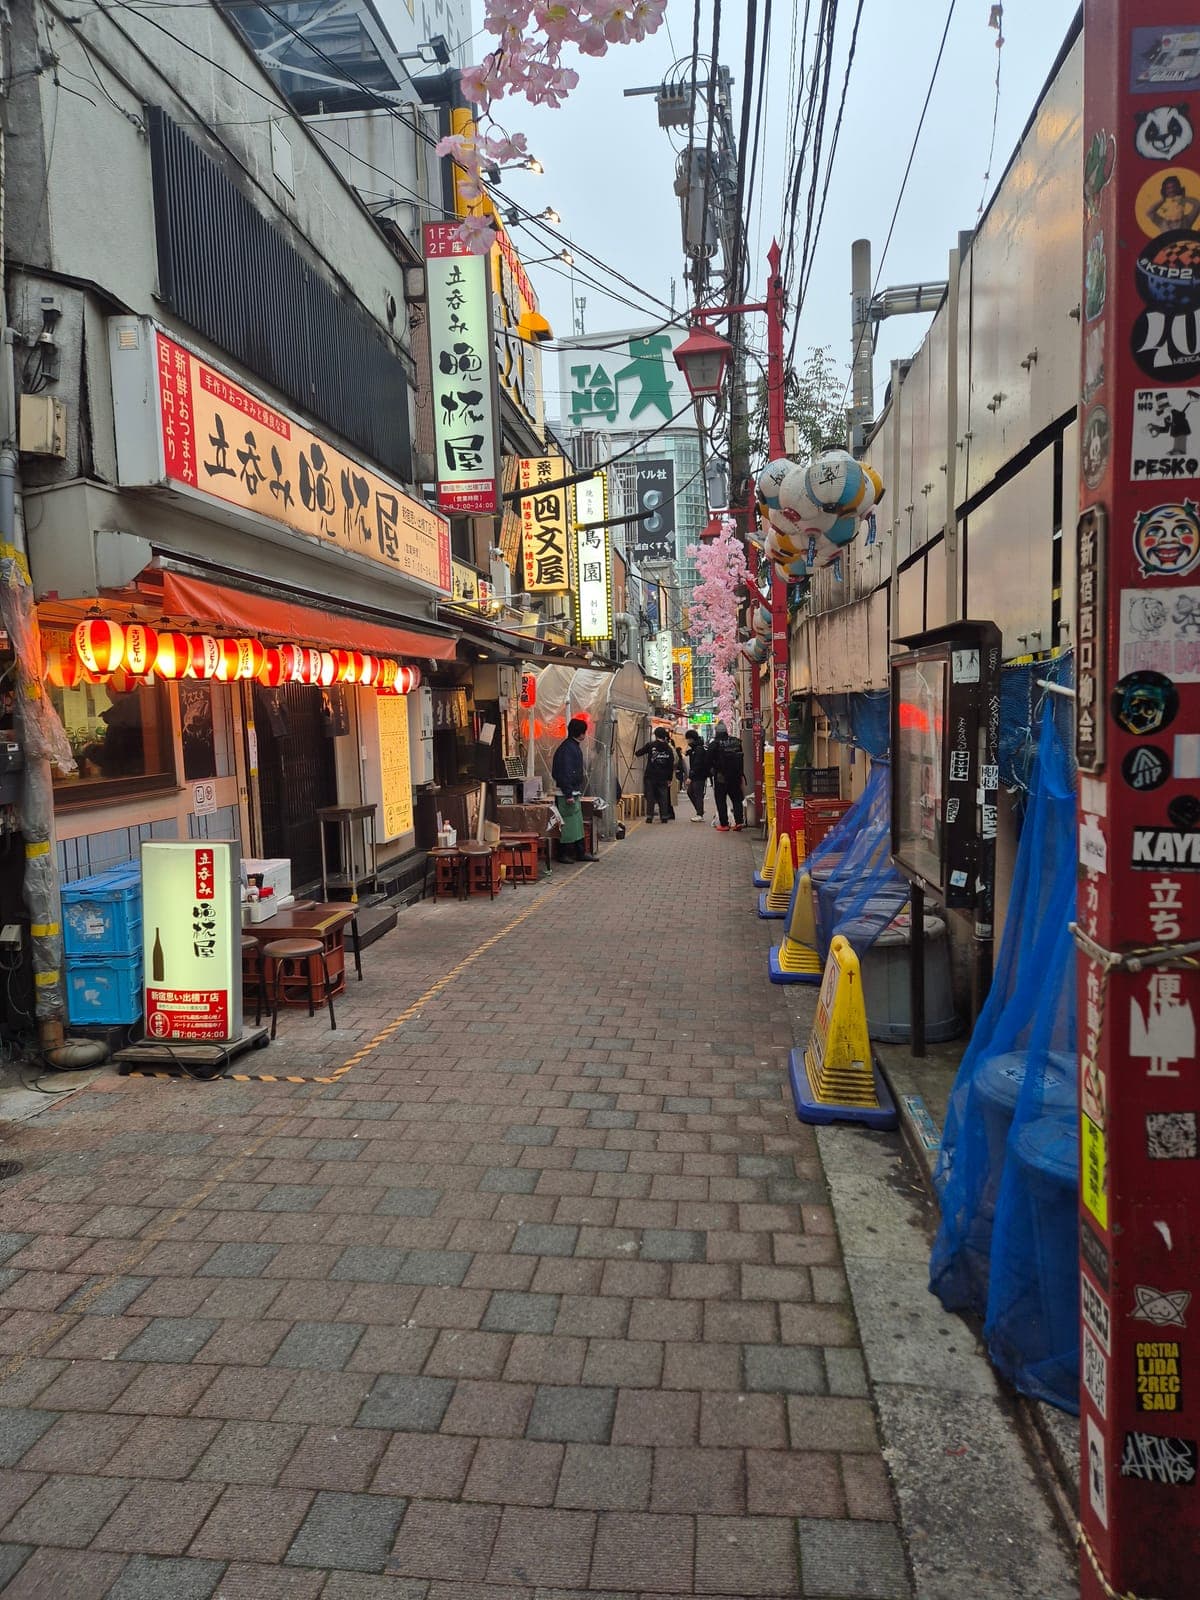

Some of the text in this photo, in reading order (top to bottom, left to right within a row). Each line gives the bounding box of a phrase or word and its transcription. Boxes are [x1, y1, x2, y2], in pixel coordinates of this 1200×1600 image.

[159, 340, 176, 460] 百十円より
[174, 350, 194, 483] 新鮮おつまみ
[1133, 458, 1199, 480] PESKO
[533, 494, 565, 584] 四文屋
[197, 853, 213, 895] 立呑み
